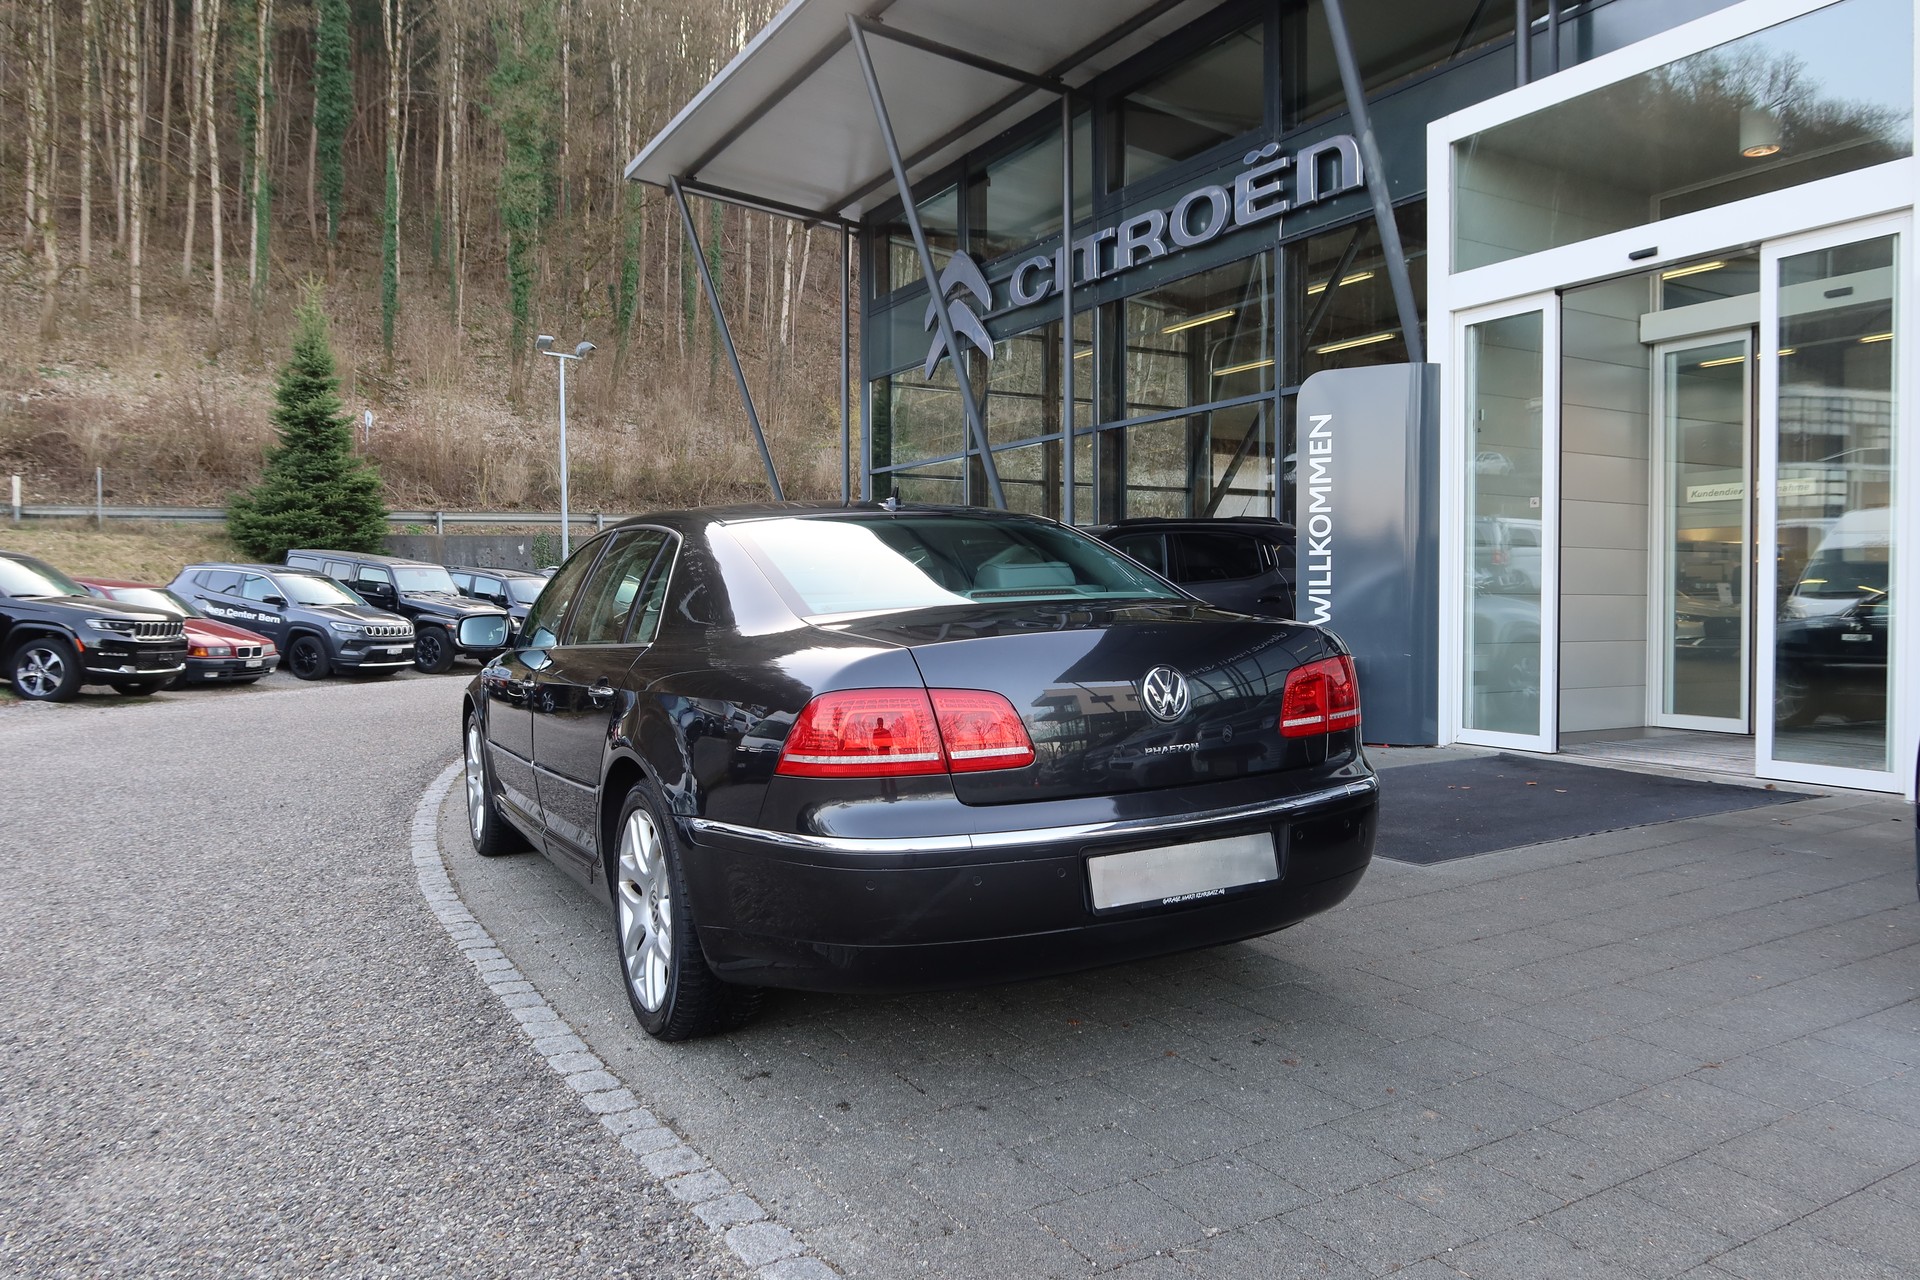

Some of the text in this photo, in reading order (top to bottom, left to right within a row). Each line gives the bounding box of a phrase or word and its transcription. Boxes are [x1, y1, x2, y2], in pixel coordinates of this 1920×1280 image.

[1308, 414, 1333, 625] WILLKOMMEN
[226, 608, 257, 620] Center
[258, 612, 280, 624] Bern
[1145, 743, 1199, 755] PHAETON
